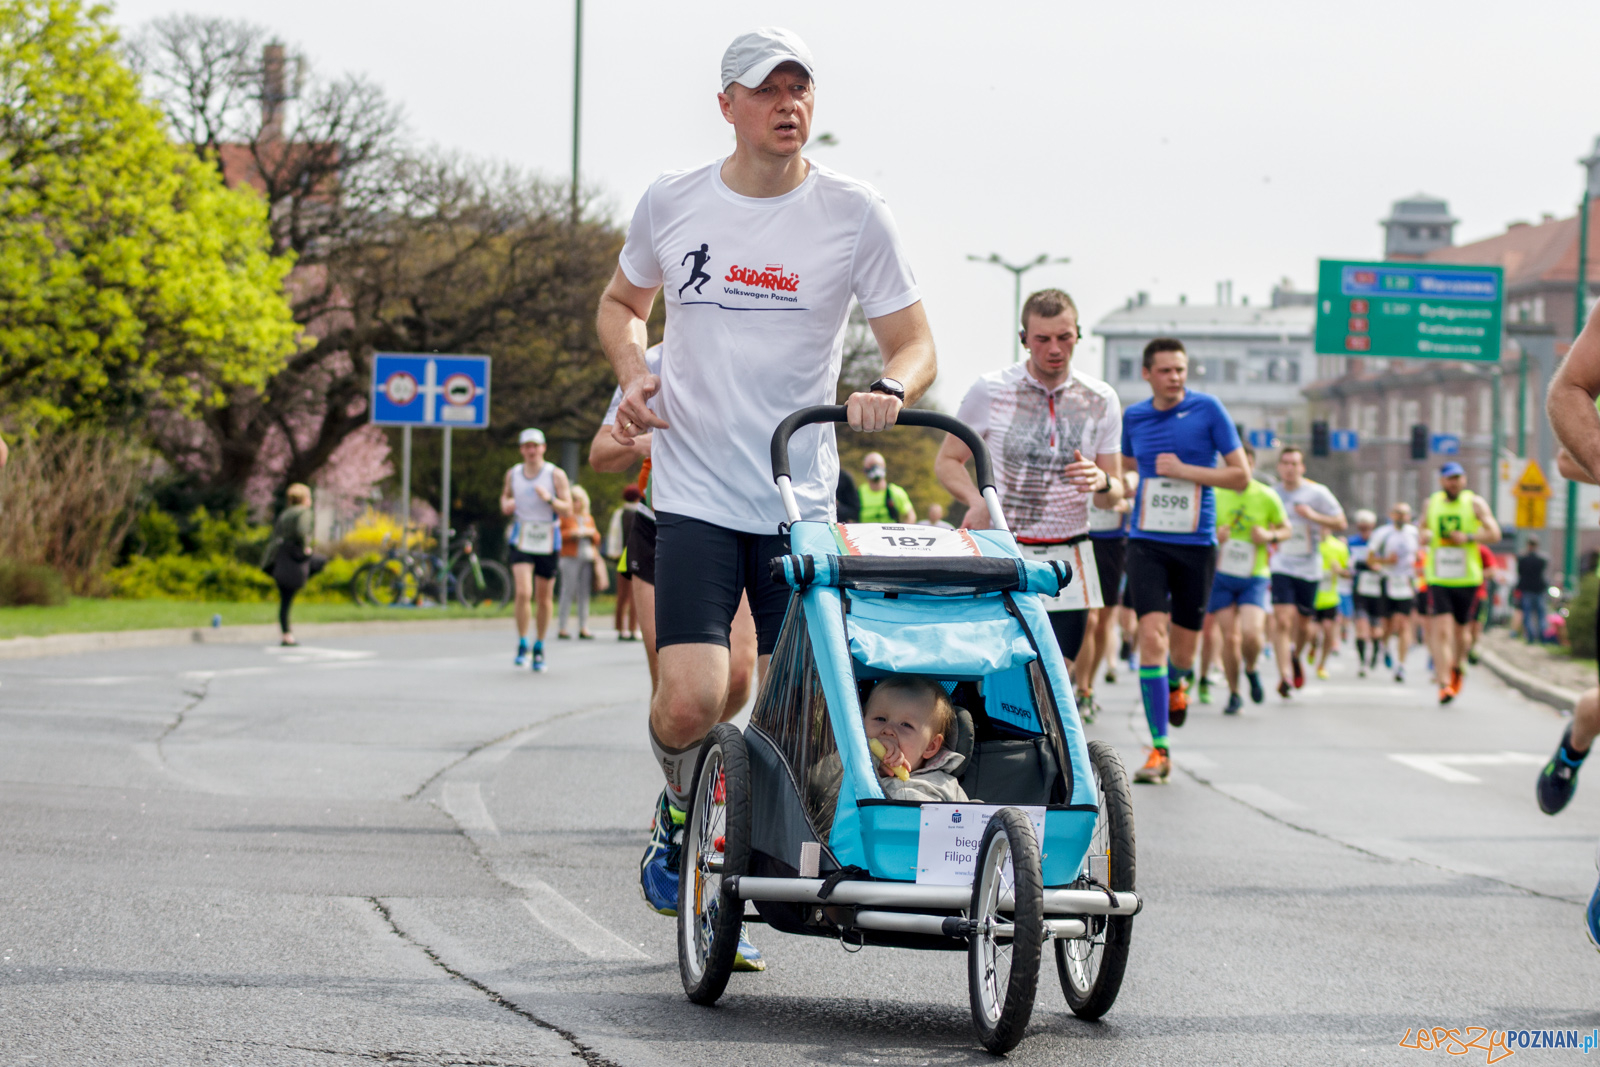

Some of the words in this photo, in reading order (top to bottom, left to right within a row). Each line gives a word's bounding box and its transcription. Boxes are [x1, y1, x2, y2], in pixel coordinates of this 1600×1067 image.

[724, 287, 769, 298] Volkswagen
[771, 293, 798, 302] Poznań
[1151, 494, 1189, 510] 8598
[881, 536, 937, 546] 187
[944, 851, 972, 864] Filipa
